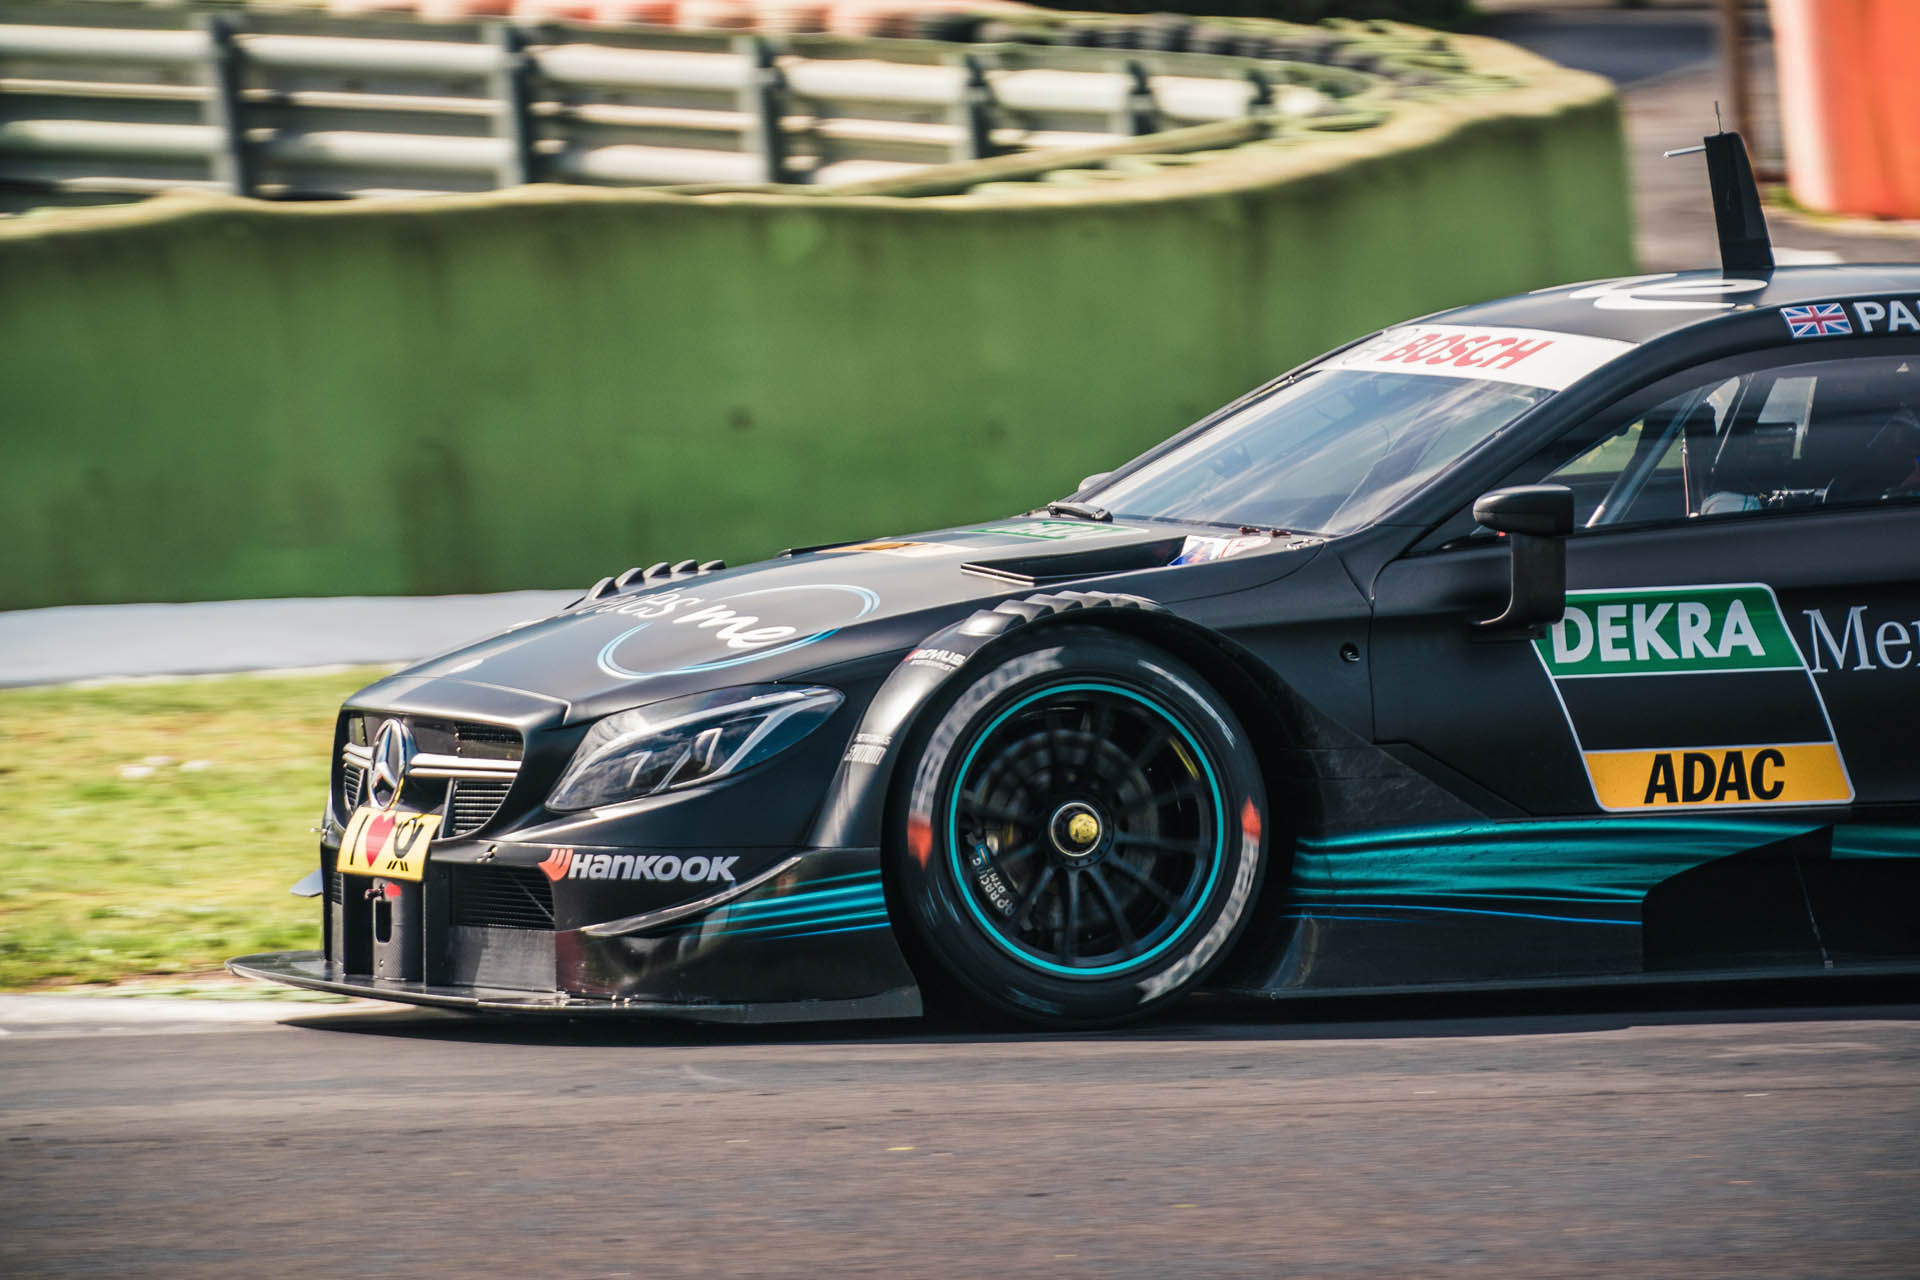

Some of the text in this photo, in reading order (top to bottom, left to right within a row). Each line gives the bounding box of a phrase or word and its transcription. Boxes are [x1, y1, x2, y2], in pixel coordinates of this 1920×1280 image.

[1853, 300, 1920, 332] PA
[1376, 333, 1556, 370] BOSCH
[1551, 599, 1766, 665] DEKRA
[1644, 748, 1785, 804] ADAC
